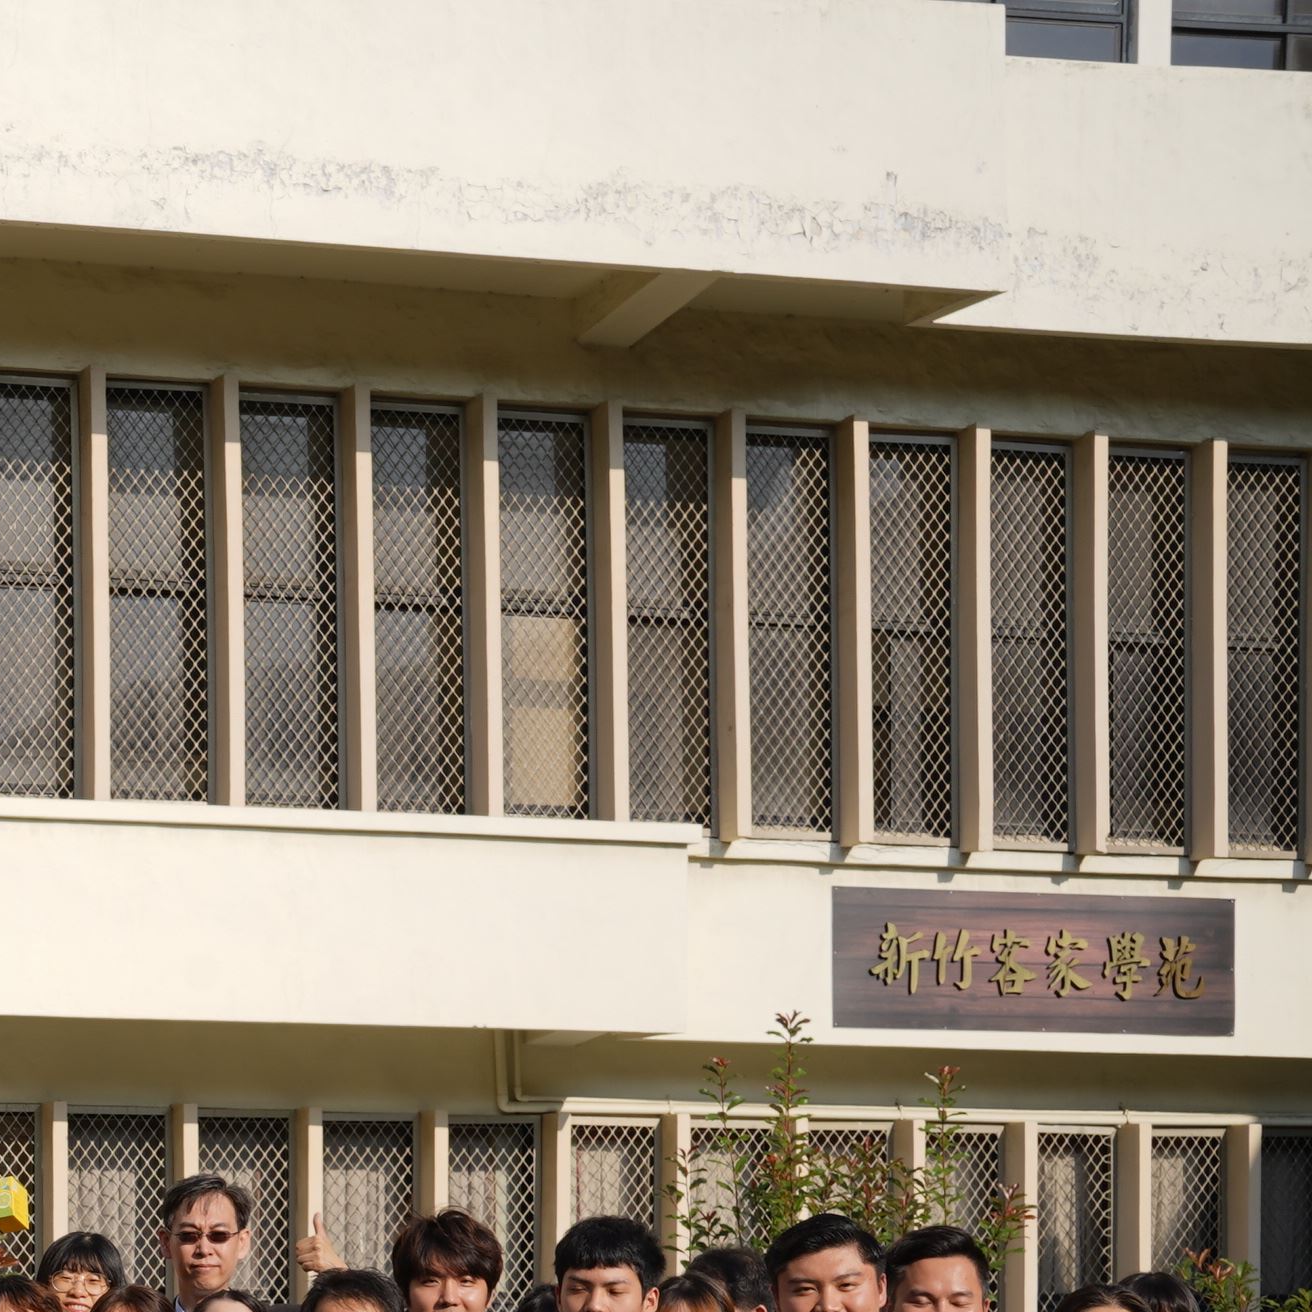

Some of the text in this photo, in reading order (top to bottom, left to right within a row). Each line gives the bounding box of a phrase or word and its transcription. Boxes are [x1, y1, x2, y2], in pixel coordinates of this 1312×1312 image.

[869, 921, 1206, 1001] 新竹客家學苑
